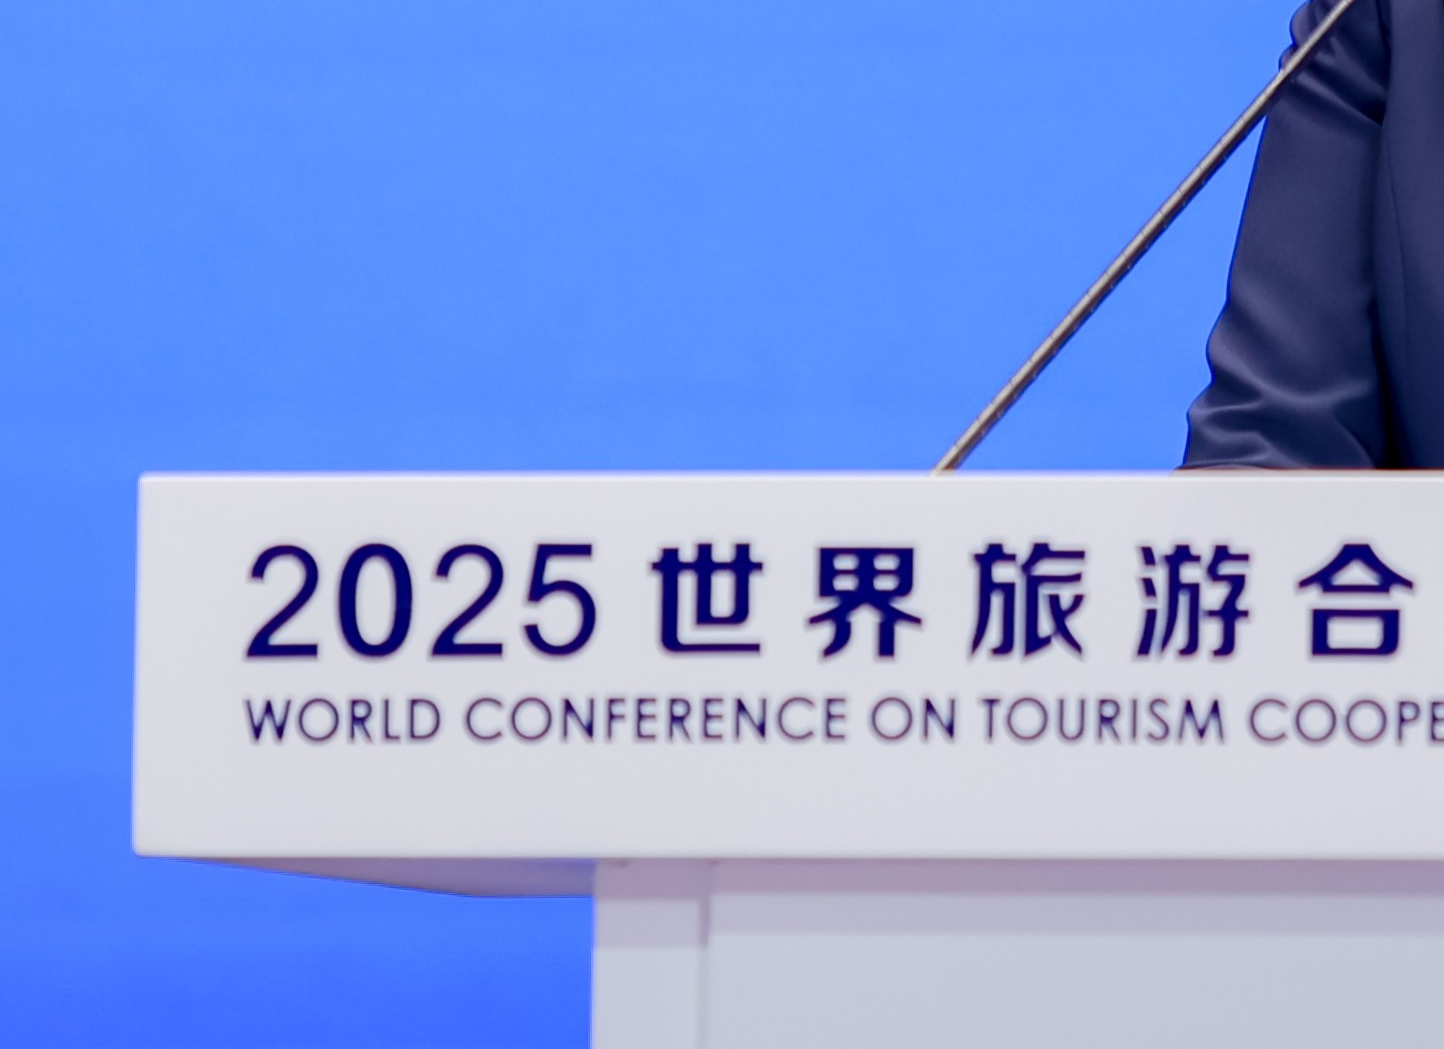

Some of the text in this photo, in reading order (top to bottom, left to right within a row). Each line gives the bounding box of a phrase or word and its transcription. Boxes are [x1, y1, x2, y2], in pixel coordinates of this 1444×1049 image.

[245, 698, 441, 743] WORLD
[464, 697, 846, 742] CONFERENCE
[870, 697, 956, 742] ON
[981, 697, 1224, 743] TOURISM
